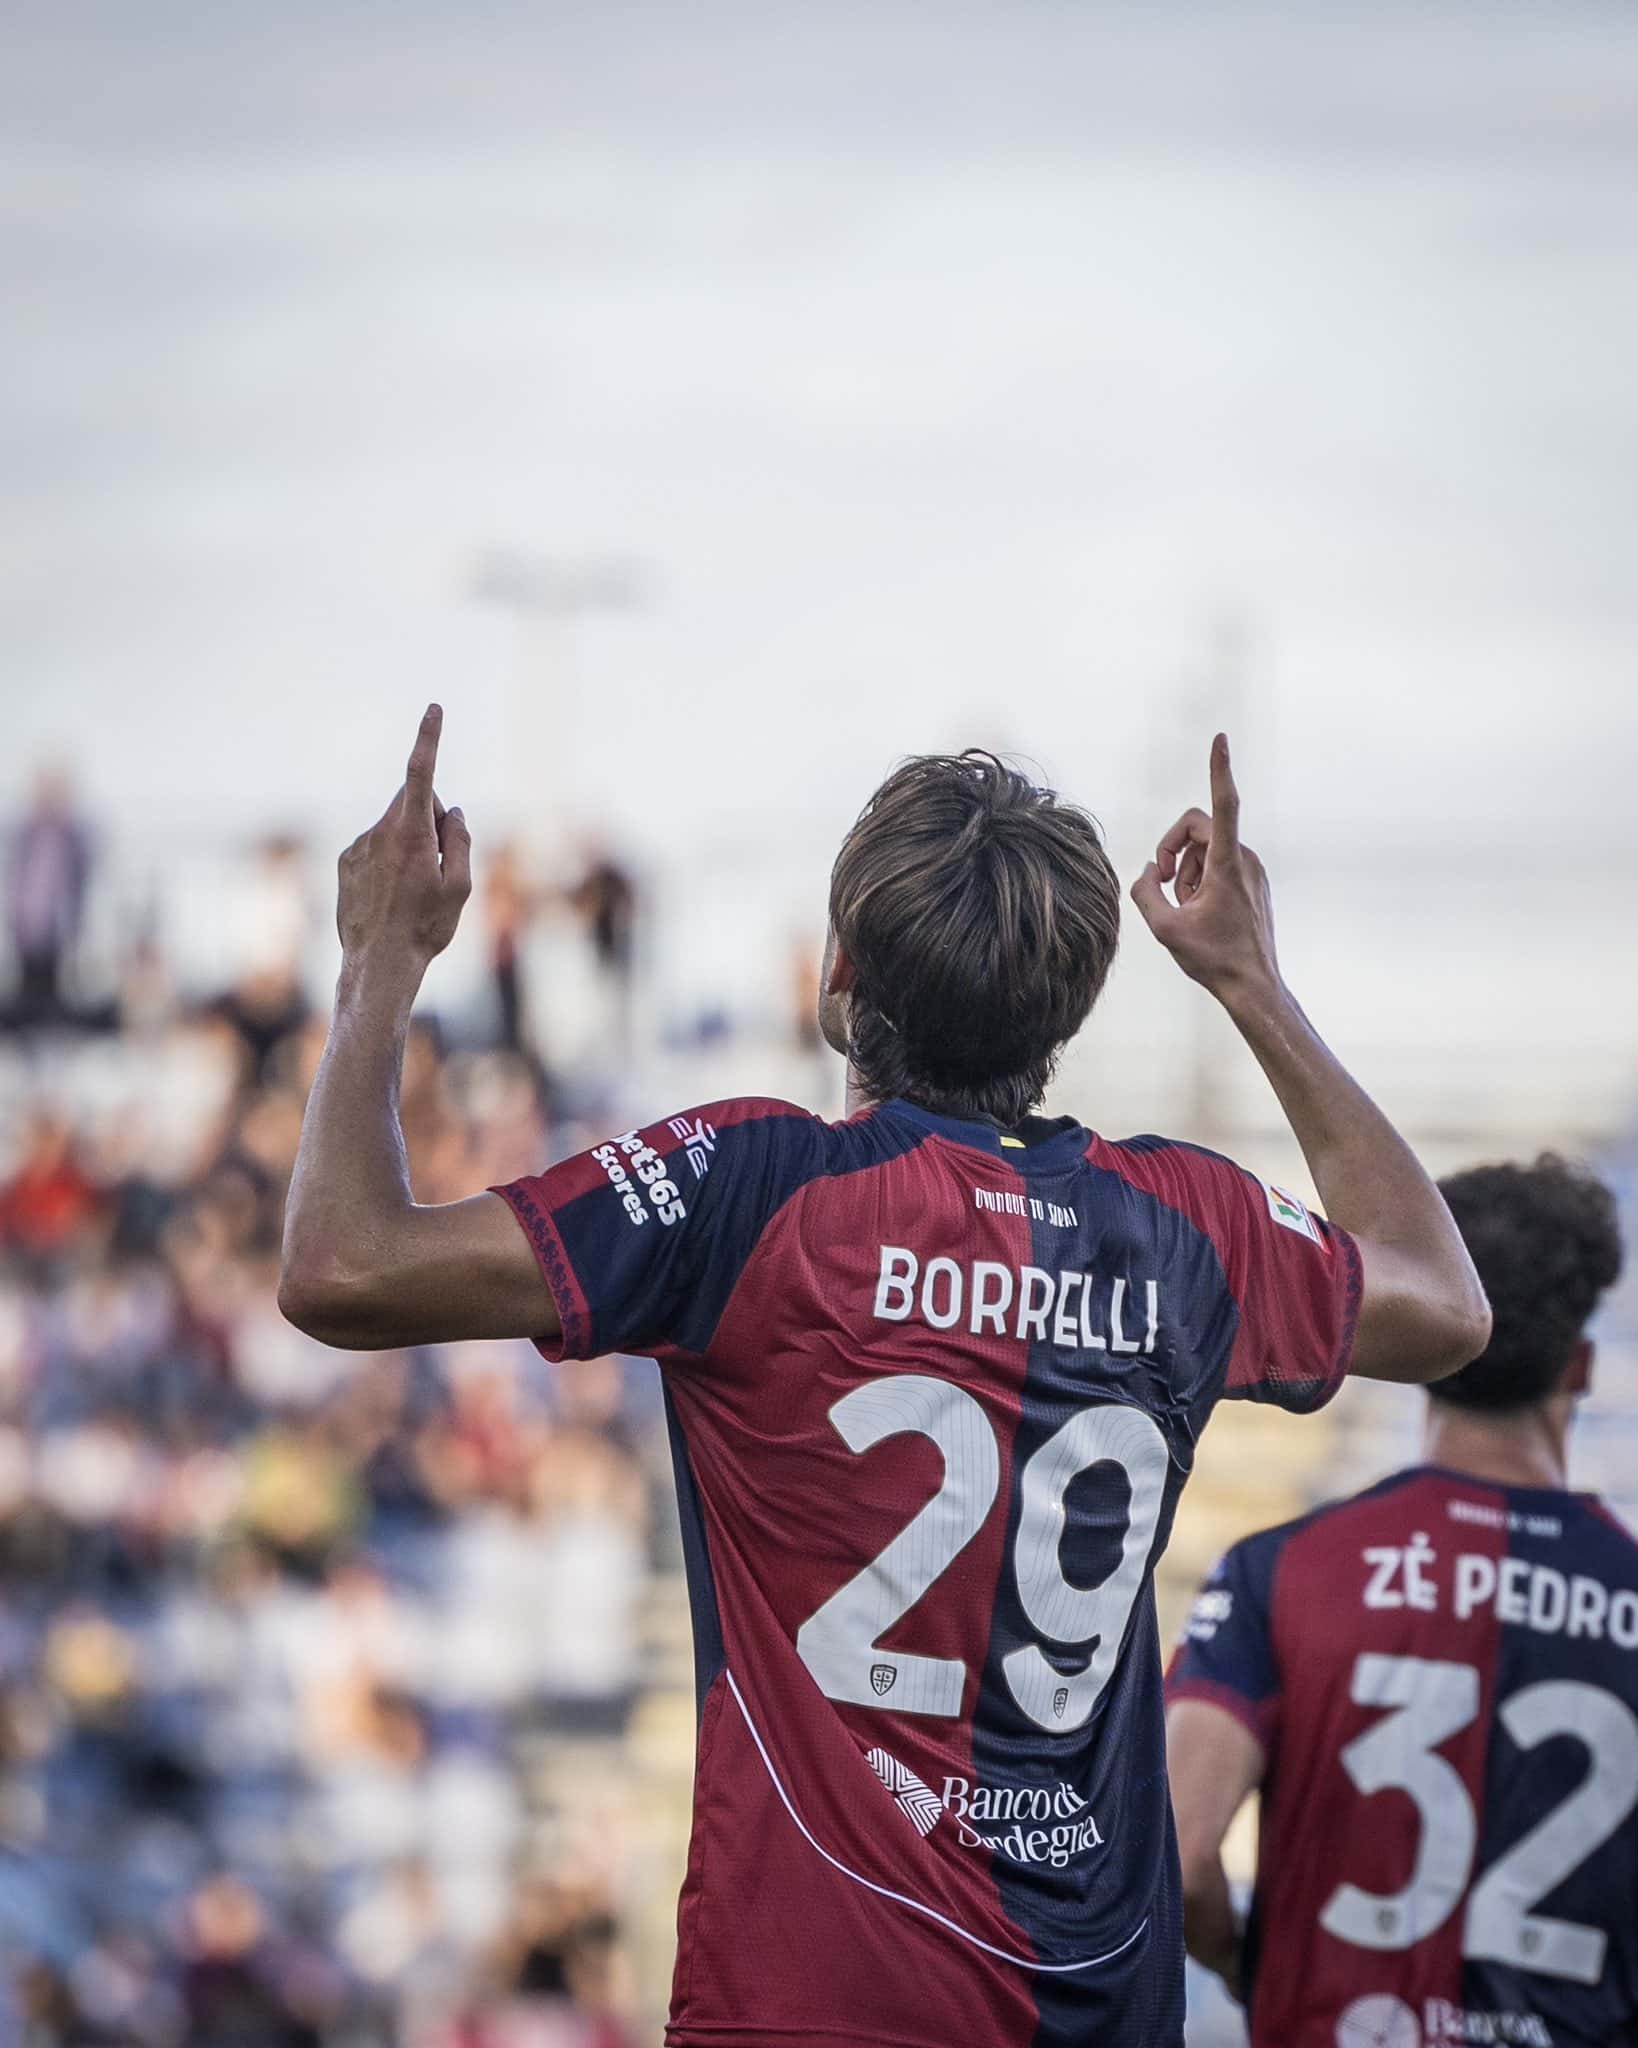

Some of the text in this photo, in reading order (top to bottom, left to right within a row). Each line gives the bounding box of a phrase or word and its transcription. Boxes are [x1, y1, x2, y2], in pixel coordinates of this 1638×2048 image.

[591, 1145, 649, 1226] scores
[873, 1244, 1158, 1353] BORRELLI
[797, 1374, 1169, 1734] 29
[1454, 1553, 1638, 1649] PEDRO
[942, 1776, 1088, 1821] Banco di
[1319, 1653, 1638, 1984] 32
